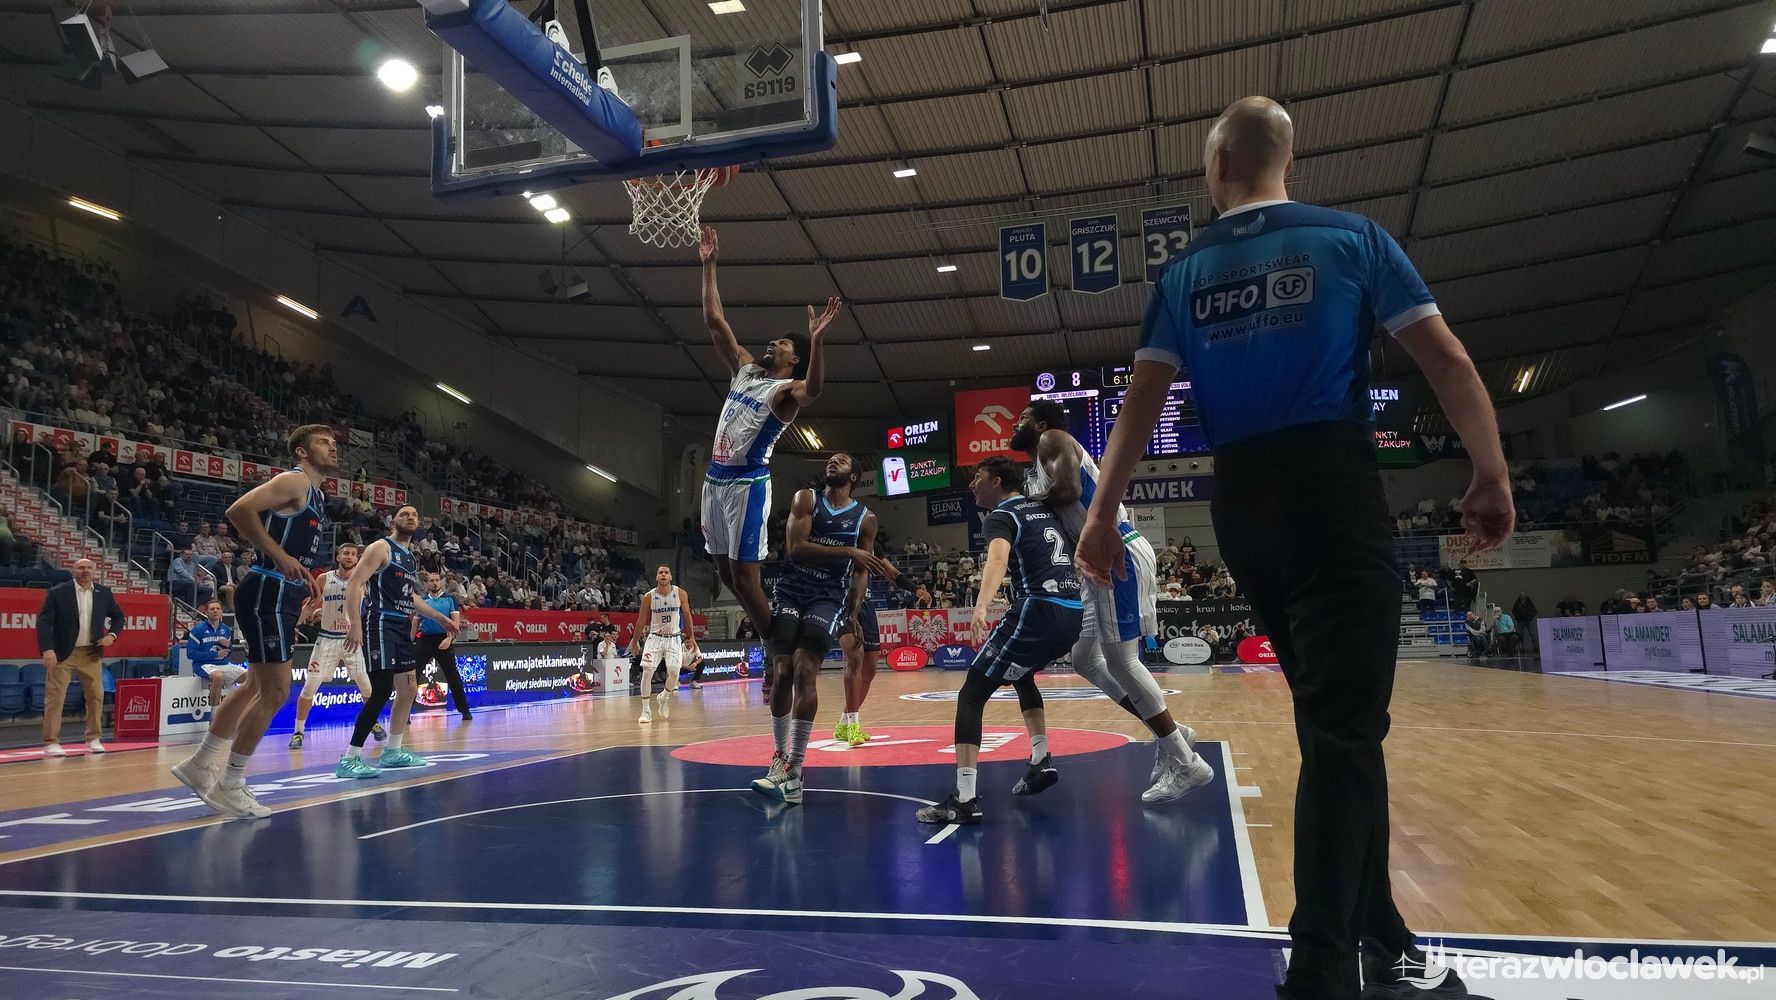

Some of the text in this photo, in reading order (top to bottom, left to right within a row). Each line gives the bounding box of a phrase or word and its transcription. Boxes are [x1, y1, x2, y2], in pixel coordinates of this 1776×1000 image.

[1144, 214, 1189, 227] SZEWCZYK
[1072, 223, 1116, 235] GRISZCZUK
[1009, 234, 1036, 243] PLUTA
[1076, 239, 1114, 275] 12
[1004, 248, 1042, 282] 10
[1224, 254, 1311, 281] SPORTSWEAR
[1072, 372, 1080, 386] 8
[1111, 404, 1118, 414] 3
[904, 420, 939, 436] ORLEN
[904, 434, 928, 447] VITAY
[968, 439, 1011, 453] ORLE
[1378, 439, 1411, 448] ZAKUPY
[909, 460, 936, 470] PUNKTY
[910, 466, 946, 479] ZA ZAKUPY
[931, 501, 962, 515] SELENKA
[1137, 513, 1155, 522] Bank
[1043, 527, 1071, 566] 2
[1591, 552, 1650, 563] FIDEM
[338, 604, 344, 613] 4
[0, 613, 37, 629] LEN
[661, 614, 672, 623] 20
[473, 622, 498, 633] ORLEN
[525, 624, 547, 633] ORLEN
[1623, 625, 1672, 643] SALAMANDER
[1552, 627, 1584, 642] SALAMANDER
[897, 651, 918, 662] Anwil
[506, 679, 528, 692] Klejnot
[528, 677, 551, 689] siedmiu
[125, 698, 150, 714] Anwil
[312, 691, 347, 708] Klejnot
[0, 933, 458, 969] Miasto dobreg
